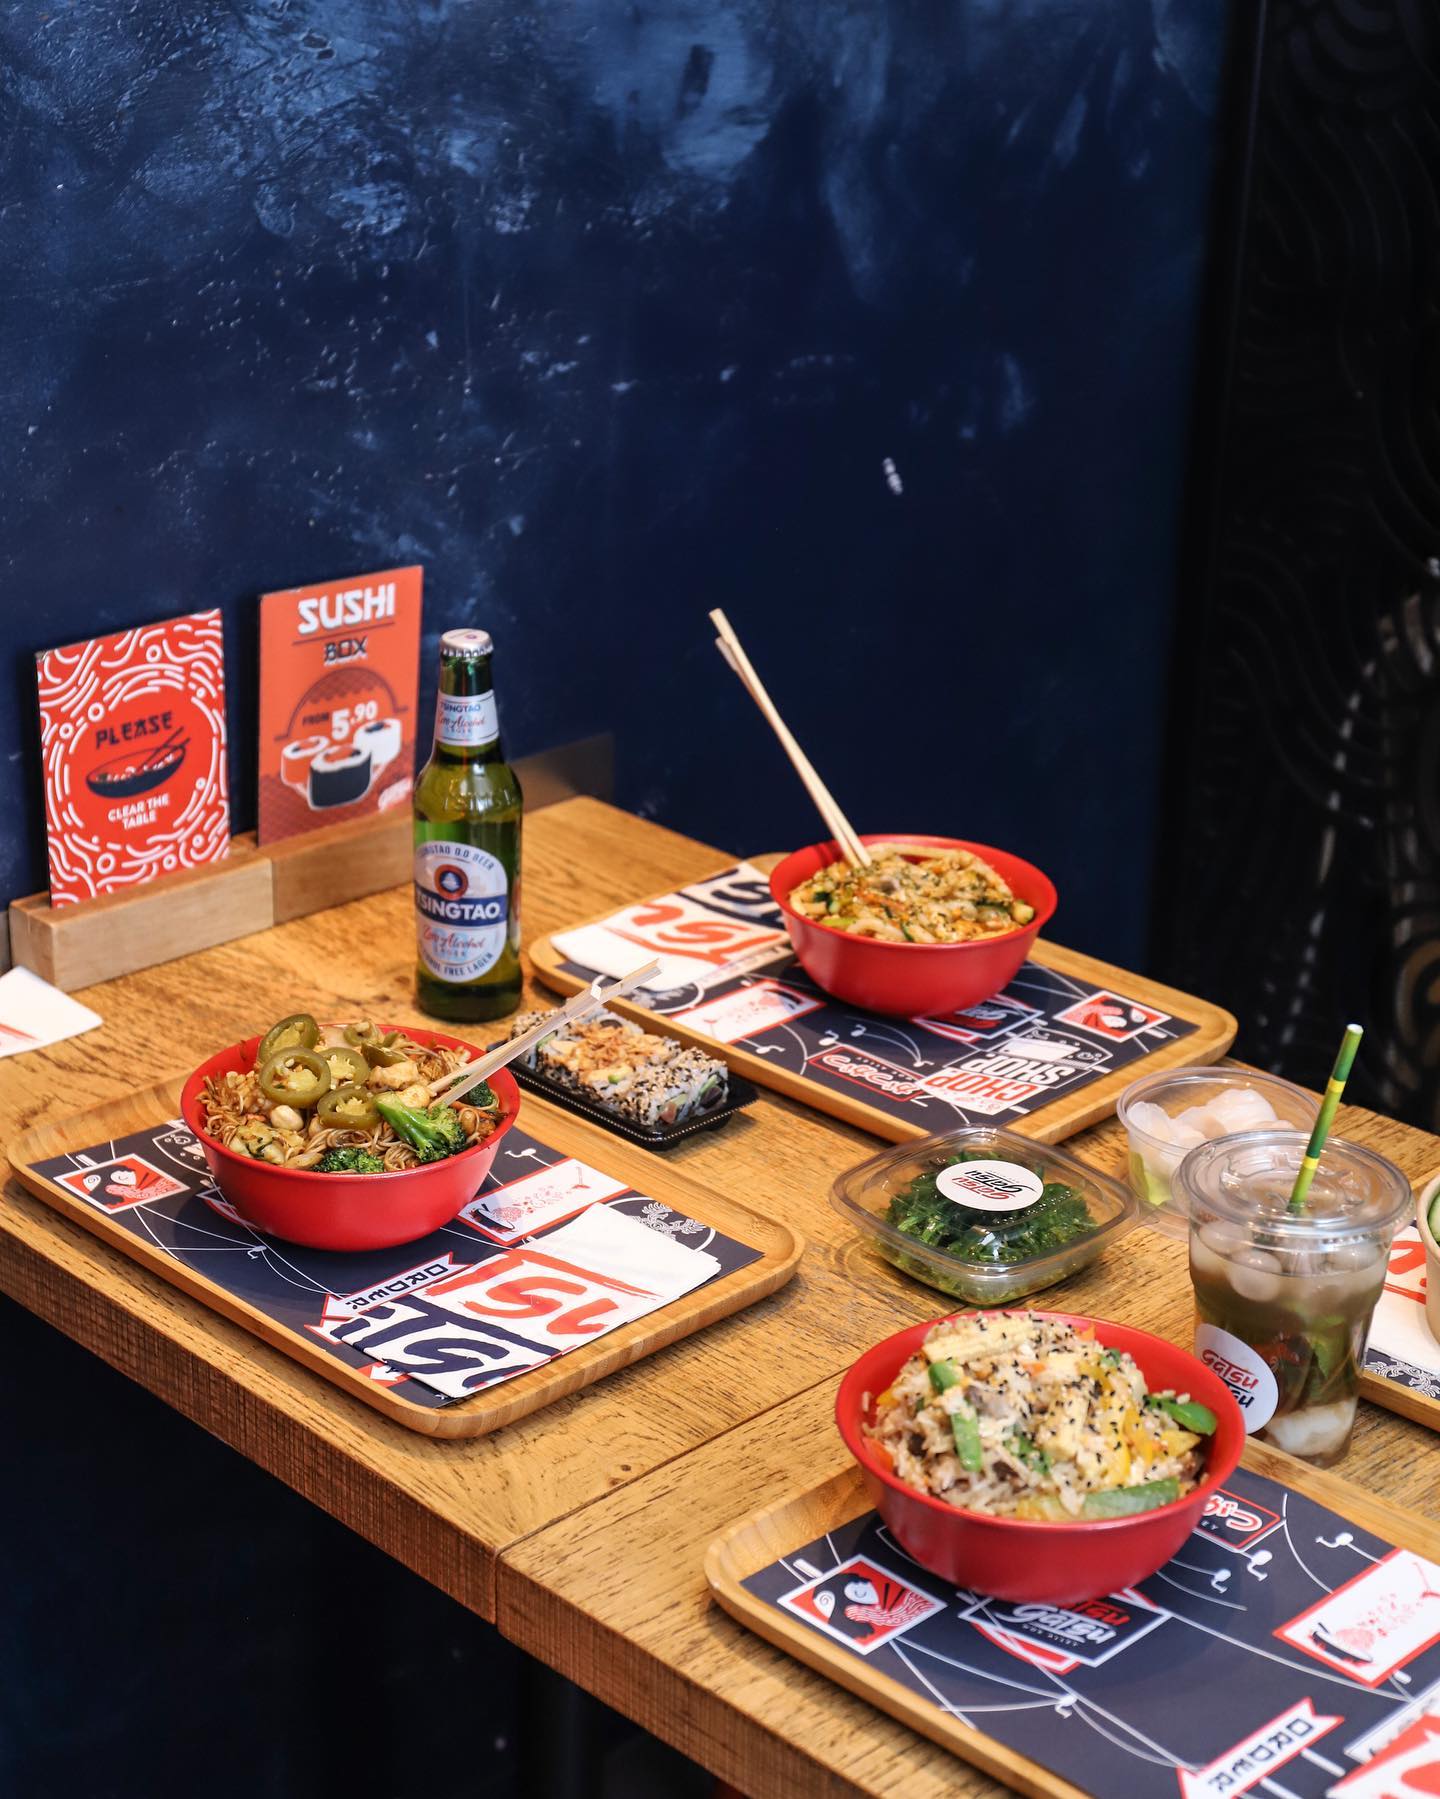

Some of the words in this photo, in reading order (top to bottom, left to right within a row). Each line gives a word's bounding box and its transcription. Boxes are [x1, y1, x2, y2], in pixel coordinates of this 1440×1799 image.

[297, 582, 396, 635] SUSHI
[324, 636, 368, 667] BOX
[96, 711, 172, 749] PLEASE
[302, 711, 330, 727] FROM
[331, 700, 378, 741] 5.90
[107, 801, 145, 823] CLEAR
[146, 793, 170, 809] THE
[122, 809, 157, 830] TABLE
[415, 894, 501, 921] TSINGTAO
